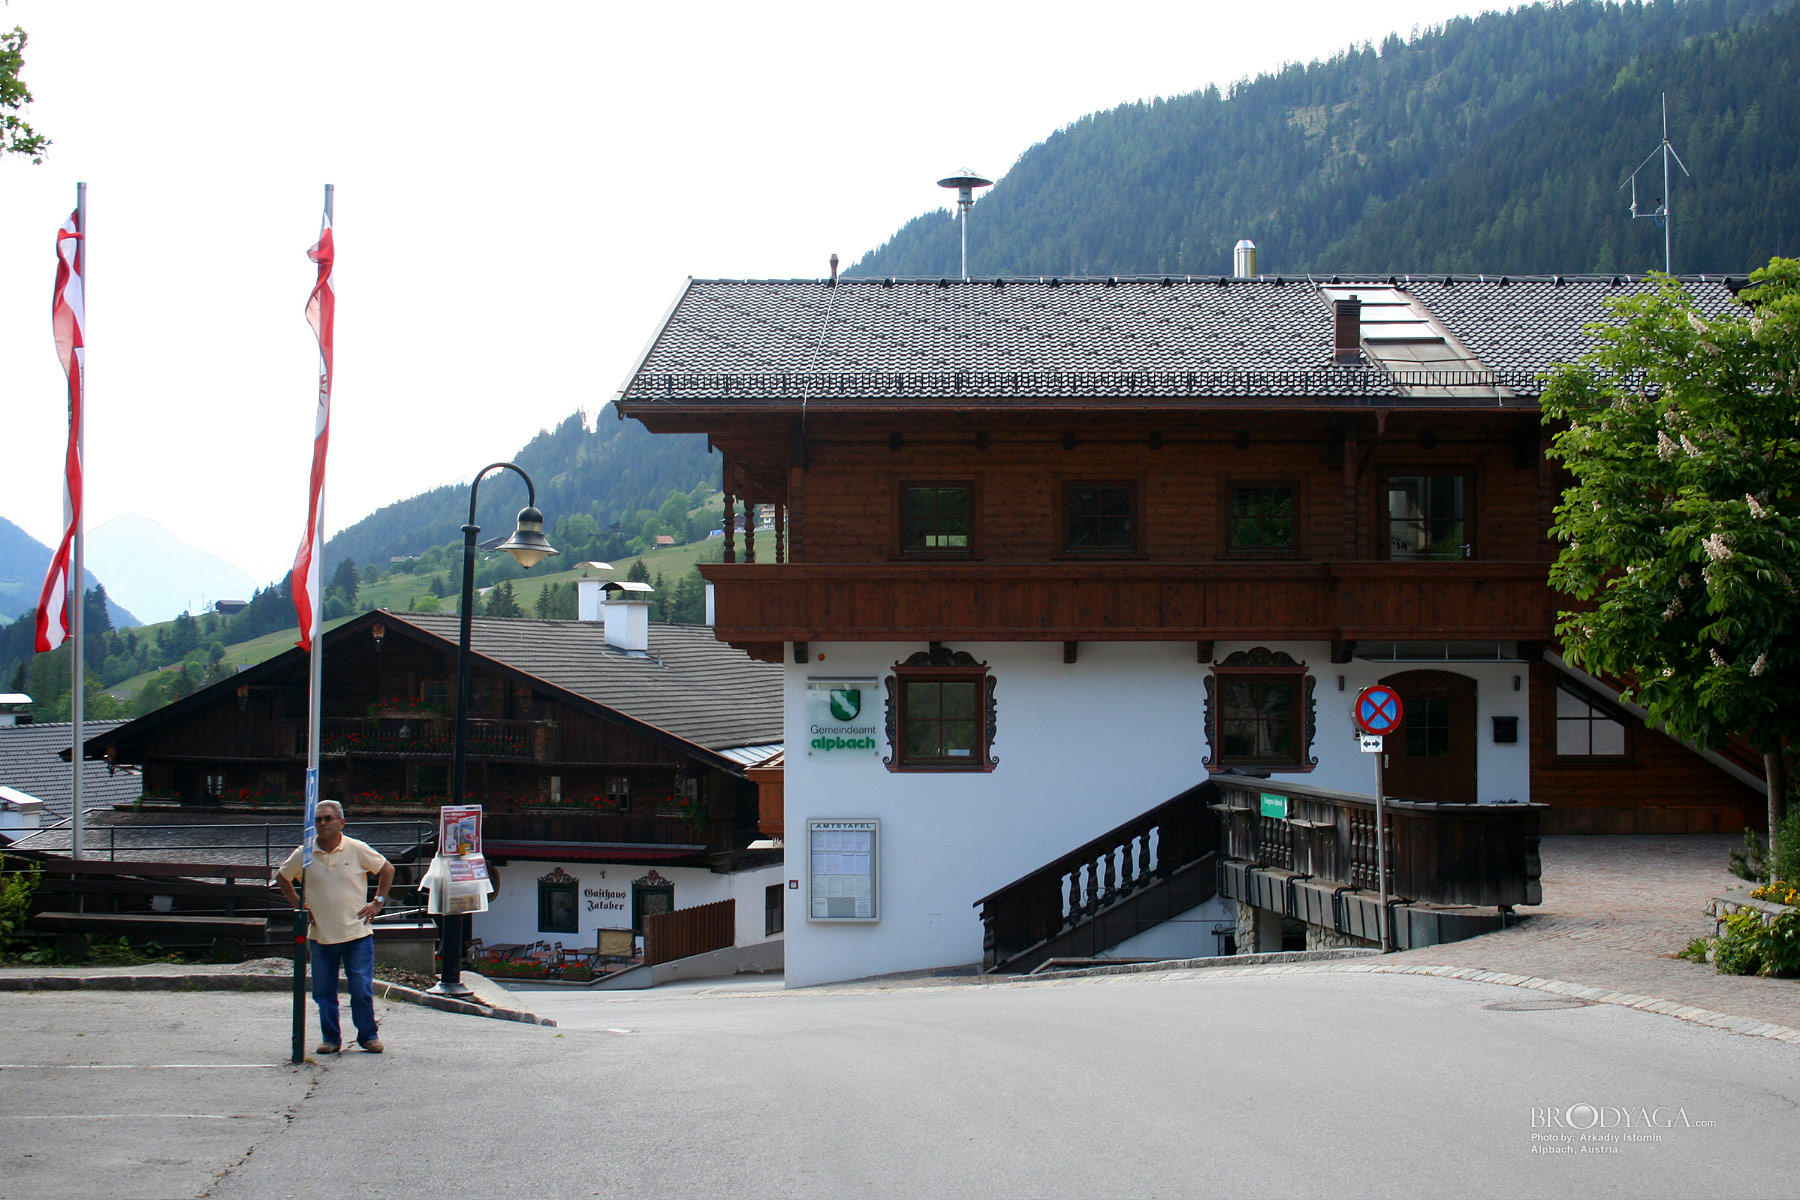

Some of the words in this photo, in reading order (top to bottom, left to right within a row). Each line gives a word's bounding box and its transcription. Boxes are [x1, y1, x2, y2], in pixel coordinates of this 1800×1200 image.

[810, 724, 876, 735] Gemeindeamt
[811, 736, 876, 751] alpbach
[584, 889, 626, 899] Gasthaus
